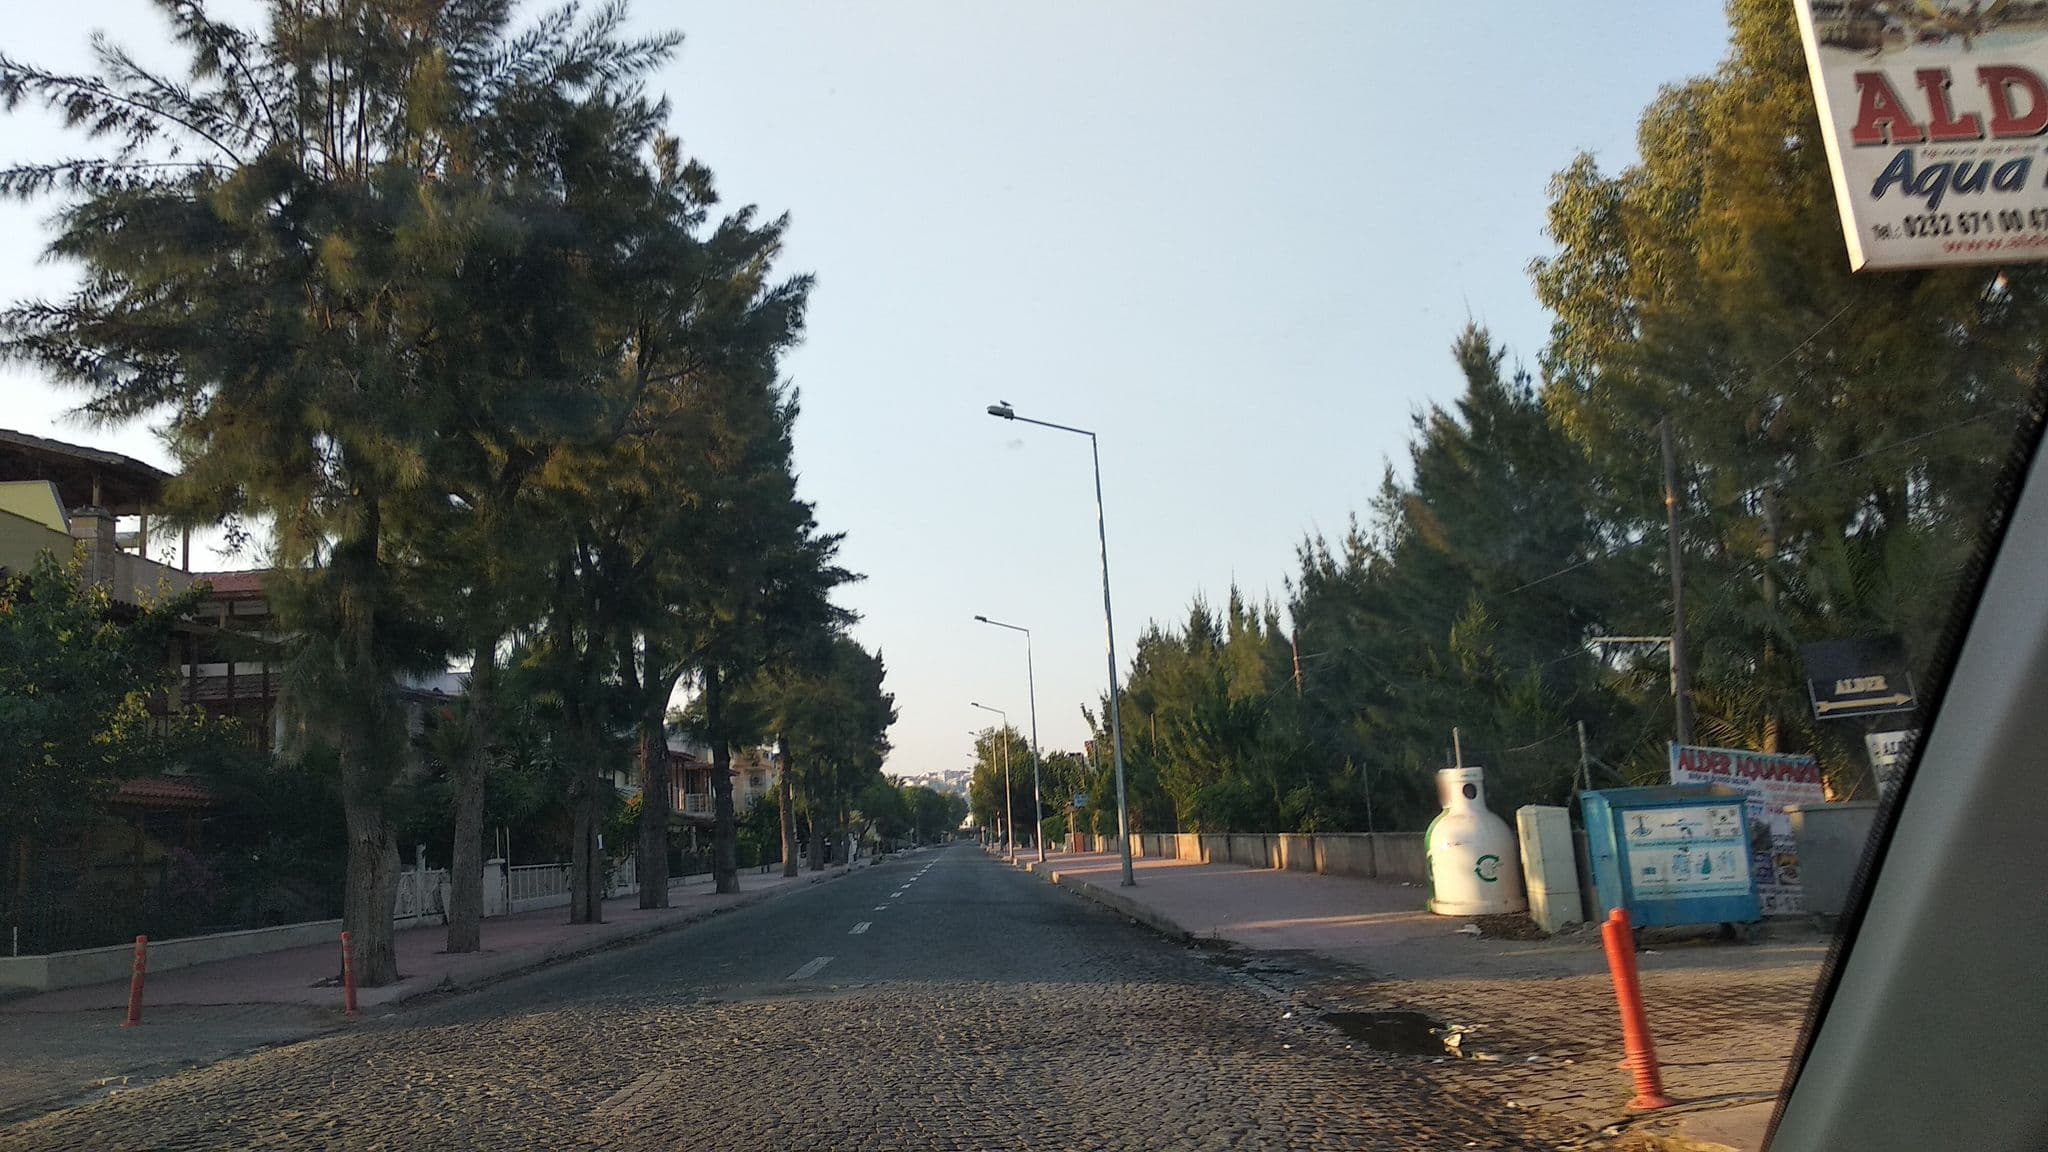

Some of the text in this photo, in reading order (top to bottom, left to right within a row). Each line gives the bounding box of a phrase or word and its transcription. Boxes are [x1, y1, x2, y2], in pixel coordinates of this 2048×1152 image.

[1871, 149, 2033, 211] Aqua
[1903, 212, 1953, 238] 0232
[1958, 210, 1993, 234] 671
[1999, 208, 2024, 232] 00
[1679, 750, 1731, 775] ALDER
